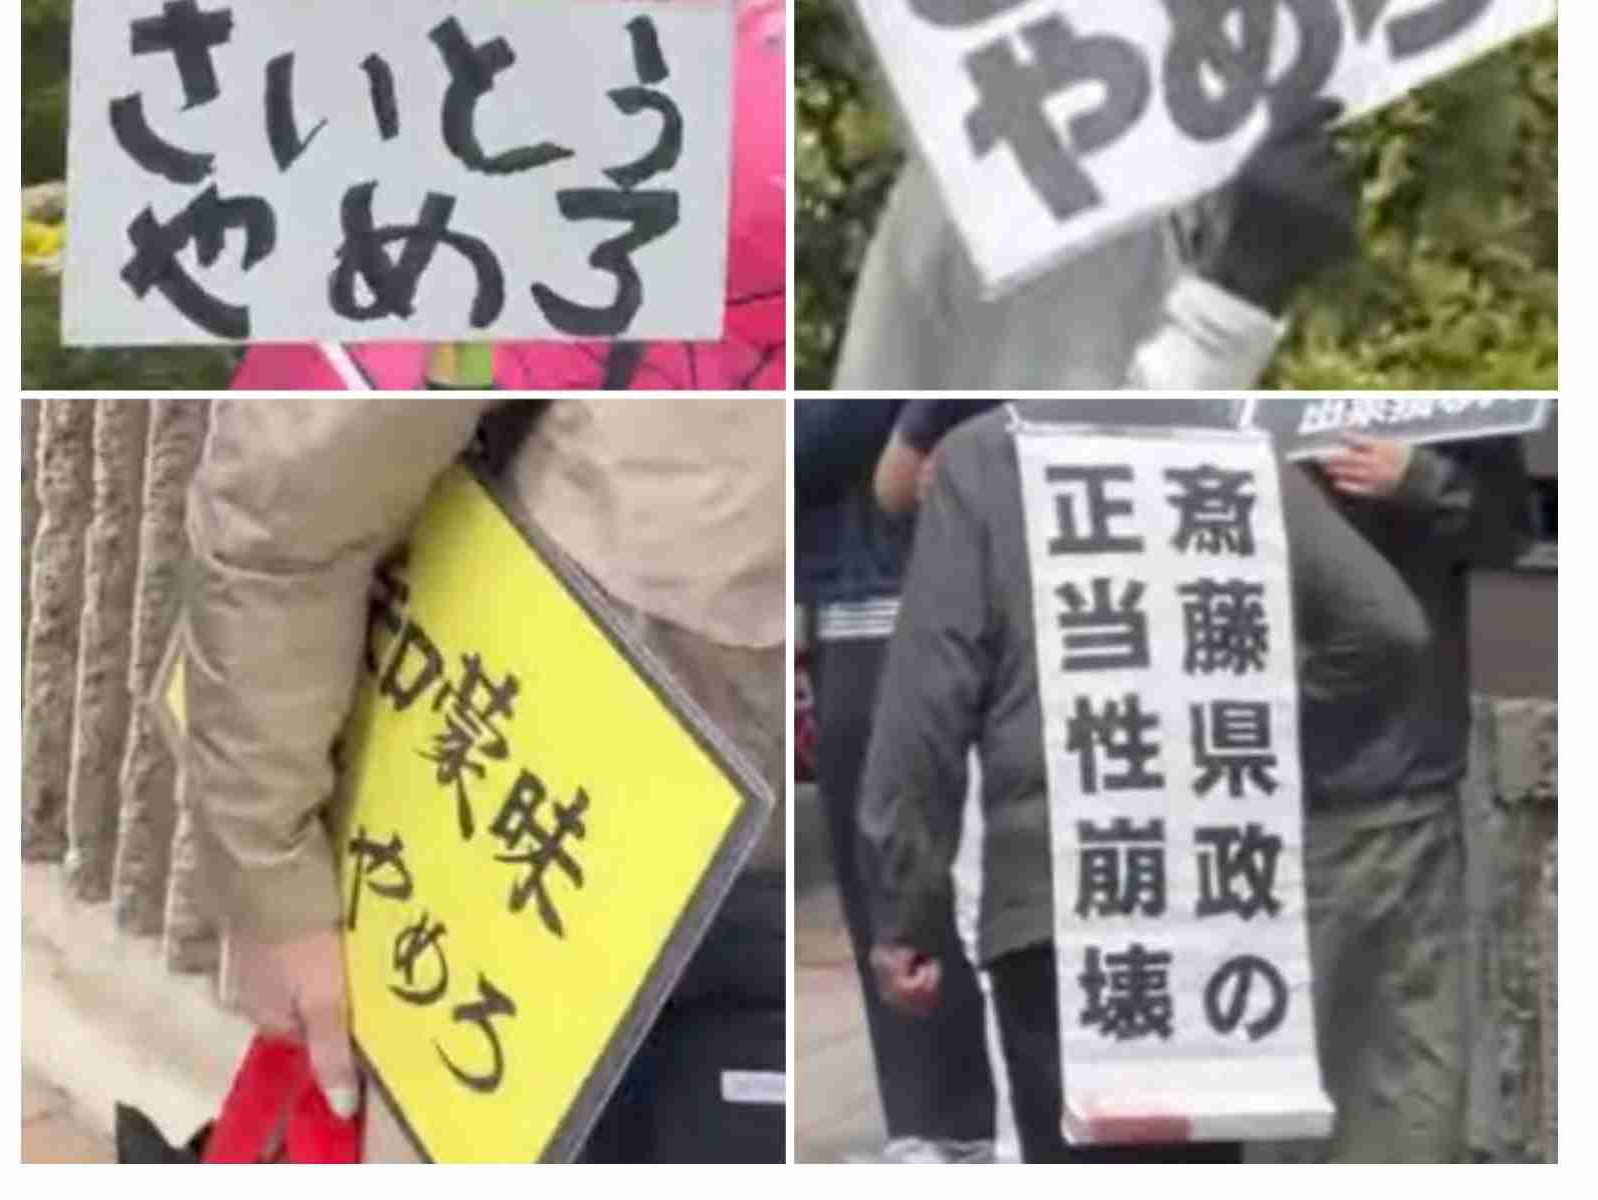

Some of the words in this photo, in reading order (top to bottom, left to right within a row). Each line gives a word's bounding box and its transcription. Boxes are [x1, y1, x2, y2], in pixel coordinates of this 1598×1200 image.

[119, 181, 681, 340] やめろ
[1043, 463, 1176, 1042] 正当性崩壊
[347, 825, 517, 1094] やめろ
